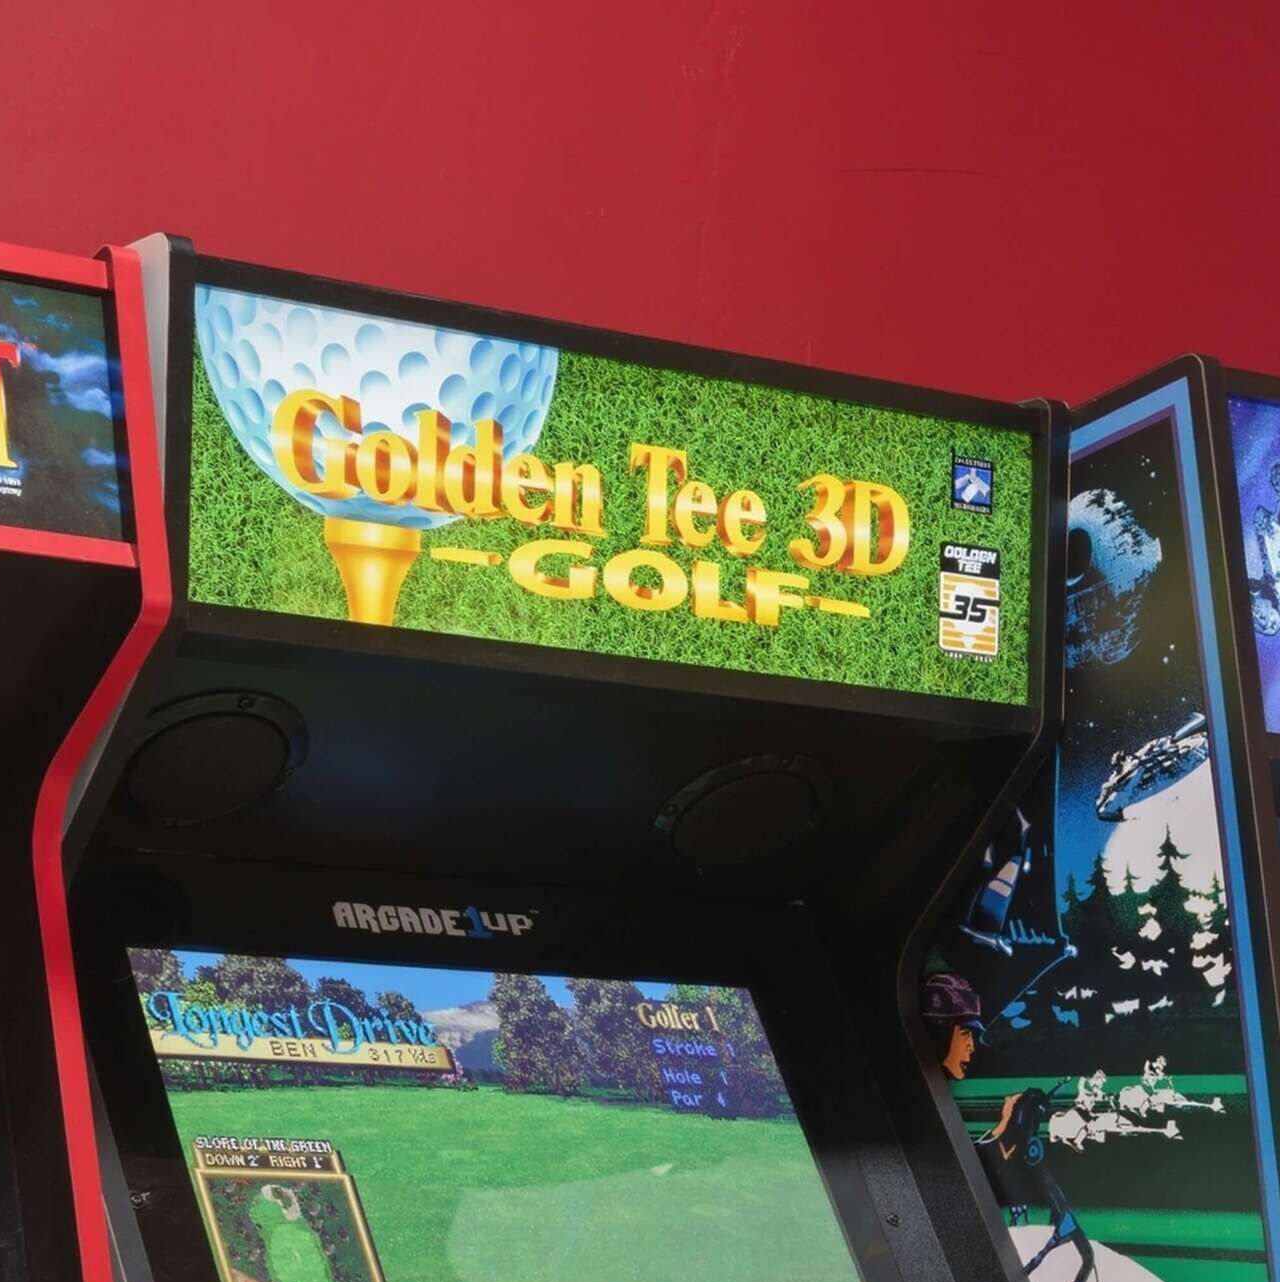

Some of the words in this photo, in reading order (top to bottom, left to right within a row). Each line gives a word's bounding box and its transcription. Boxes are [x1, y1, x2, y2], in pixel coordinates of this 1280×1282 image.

[270, 387, 605, 538] Golden
[628, 442, 767, 557] Tee
[790, 473, 911, 577] 3D
[943, 545, 998, 565] GOLDEN
[957, 559, 983, 575] TEE
[952, 593, 989, 623] 35
[331, 901, 533, 940] ARCADE1UP
[145, 990, 304, 1051] Longest
[308, 998, 439, 1056] Drive
[636, 1002, 701, 1031] Golfer
[269, 1040, 318, 1058] BEN
[367, 1047, 404, 1064] 317
[651, 1038, 718, 1057] Stroke
[662, 1067, 703, 1085] Hole
[670, 1089, 704, 1107] Par
[204, 1153, 246, 1167] DOWN
[269, 1154, 308, 1168] RIGHT
